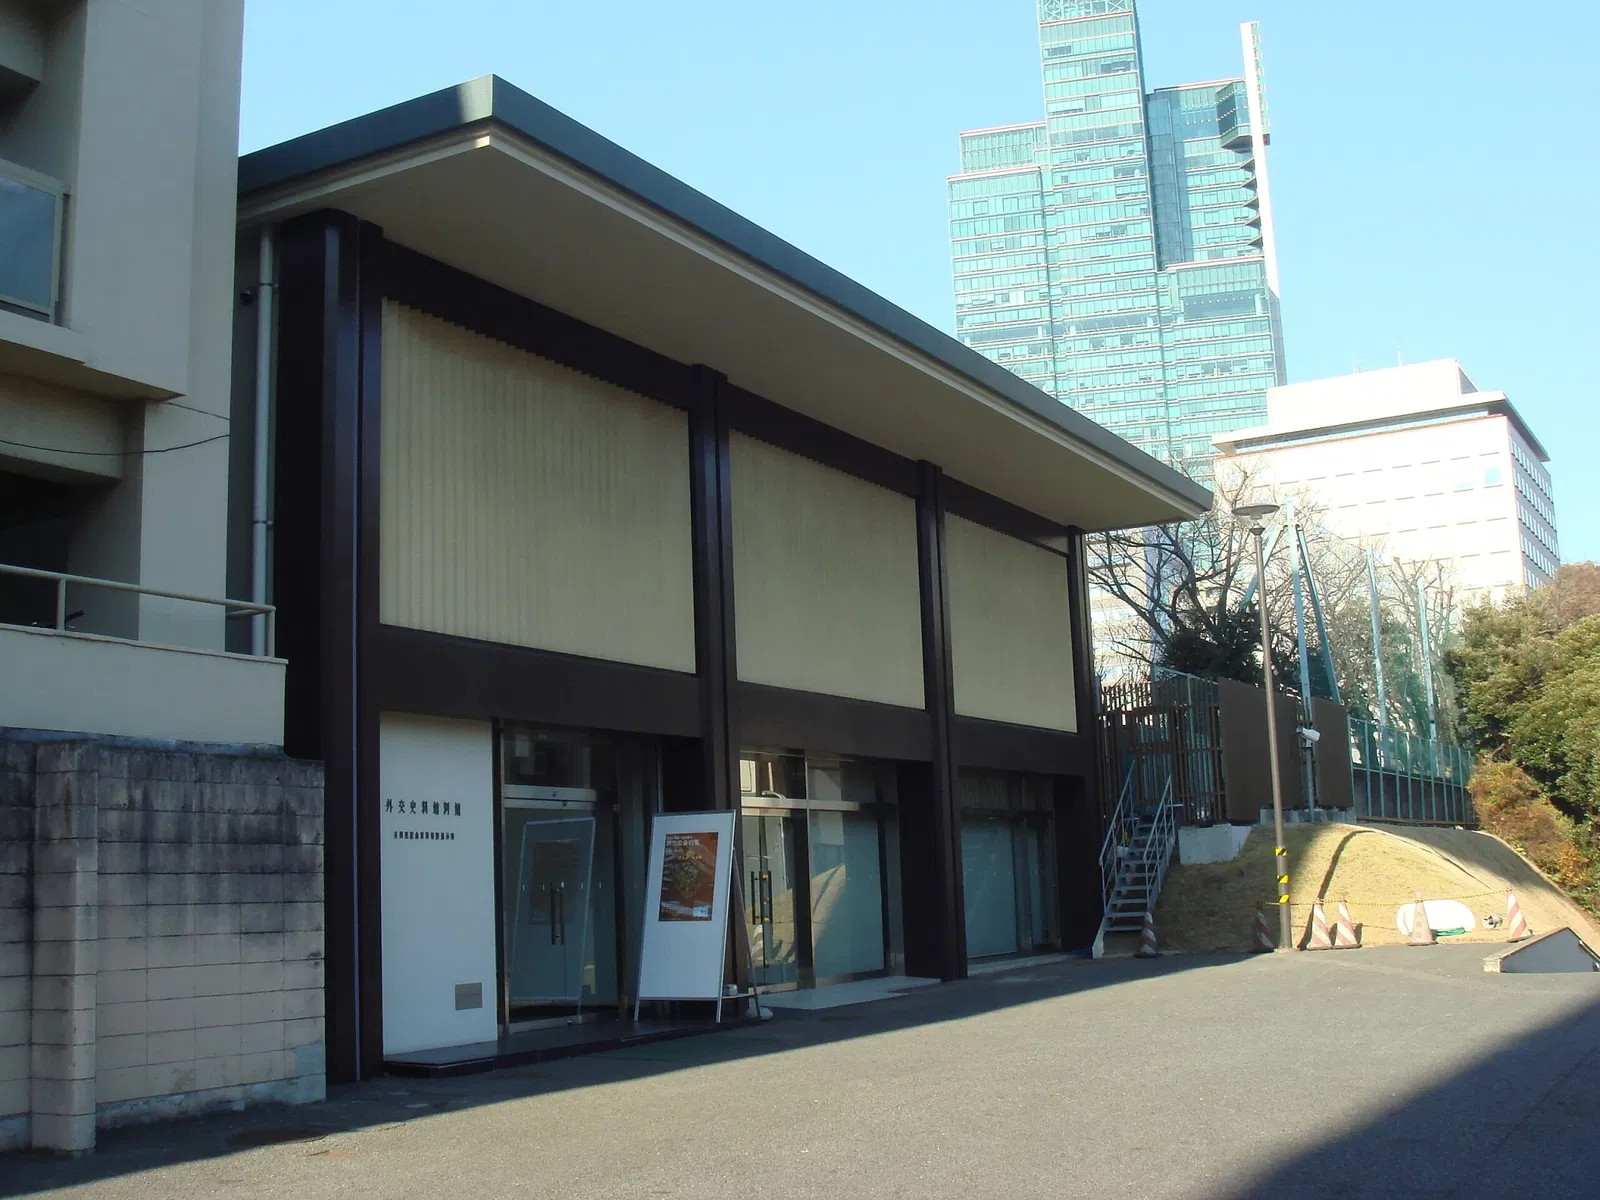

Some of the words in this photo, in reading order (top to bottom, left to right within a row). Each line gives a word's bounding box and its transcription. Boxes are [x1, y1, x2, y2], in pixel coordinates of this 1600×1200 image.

[386, 798, 461, 816] 外交史料館別館
